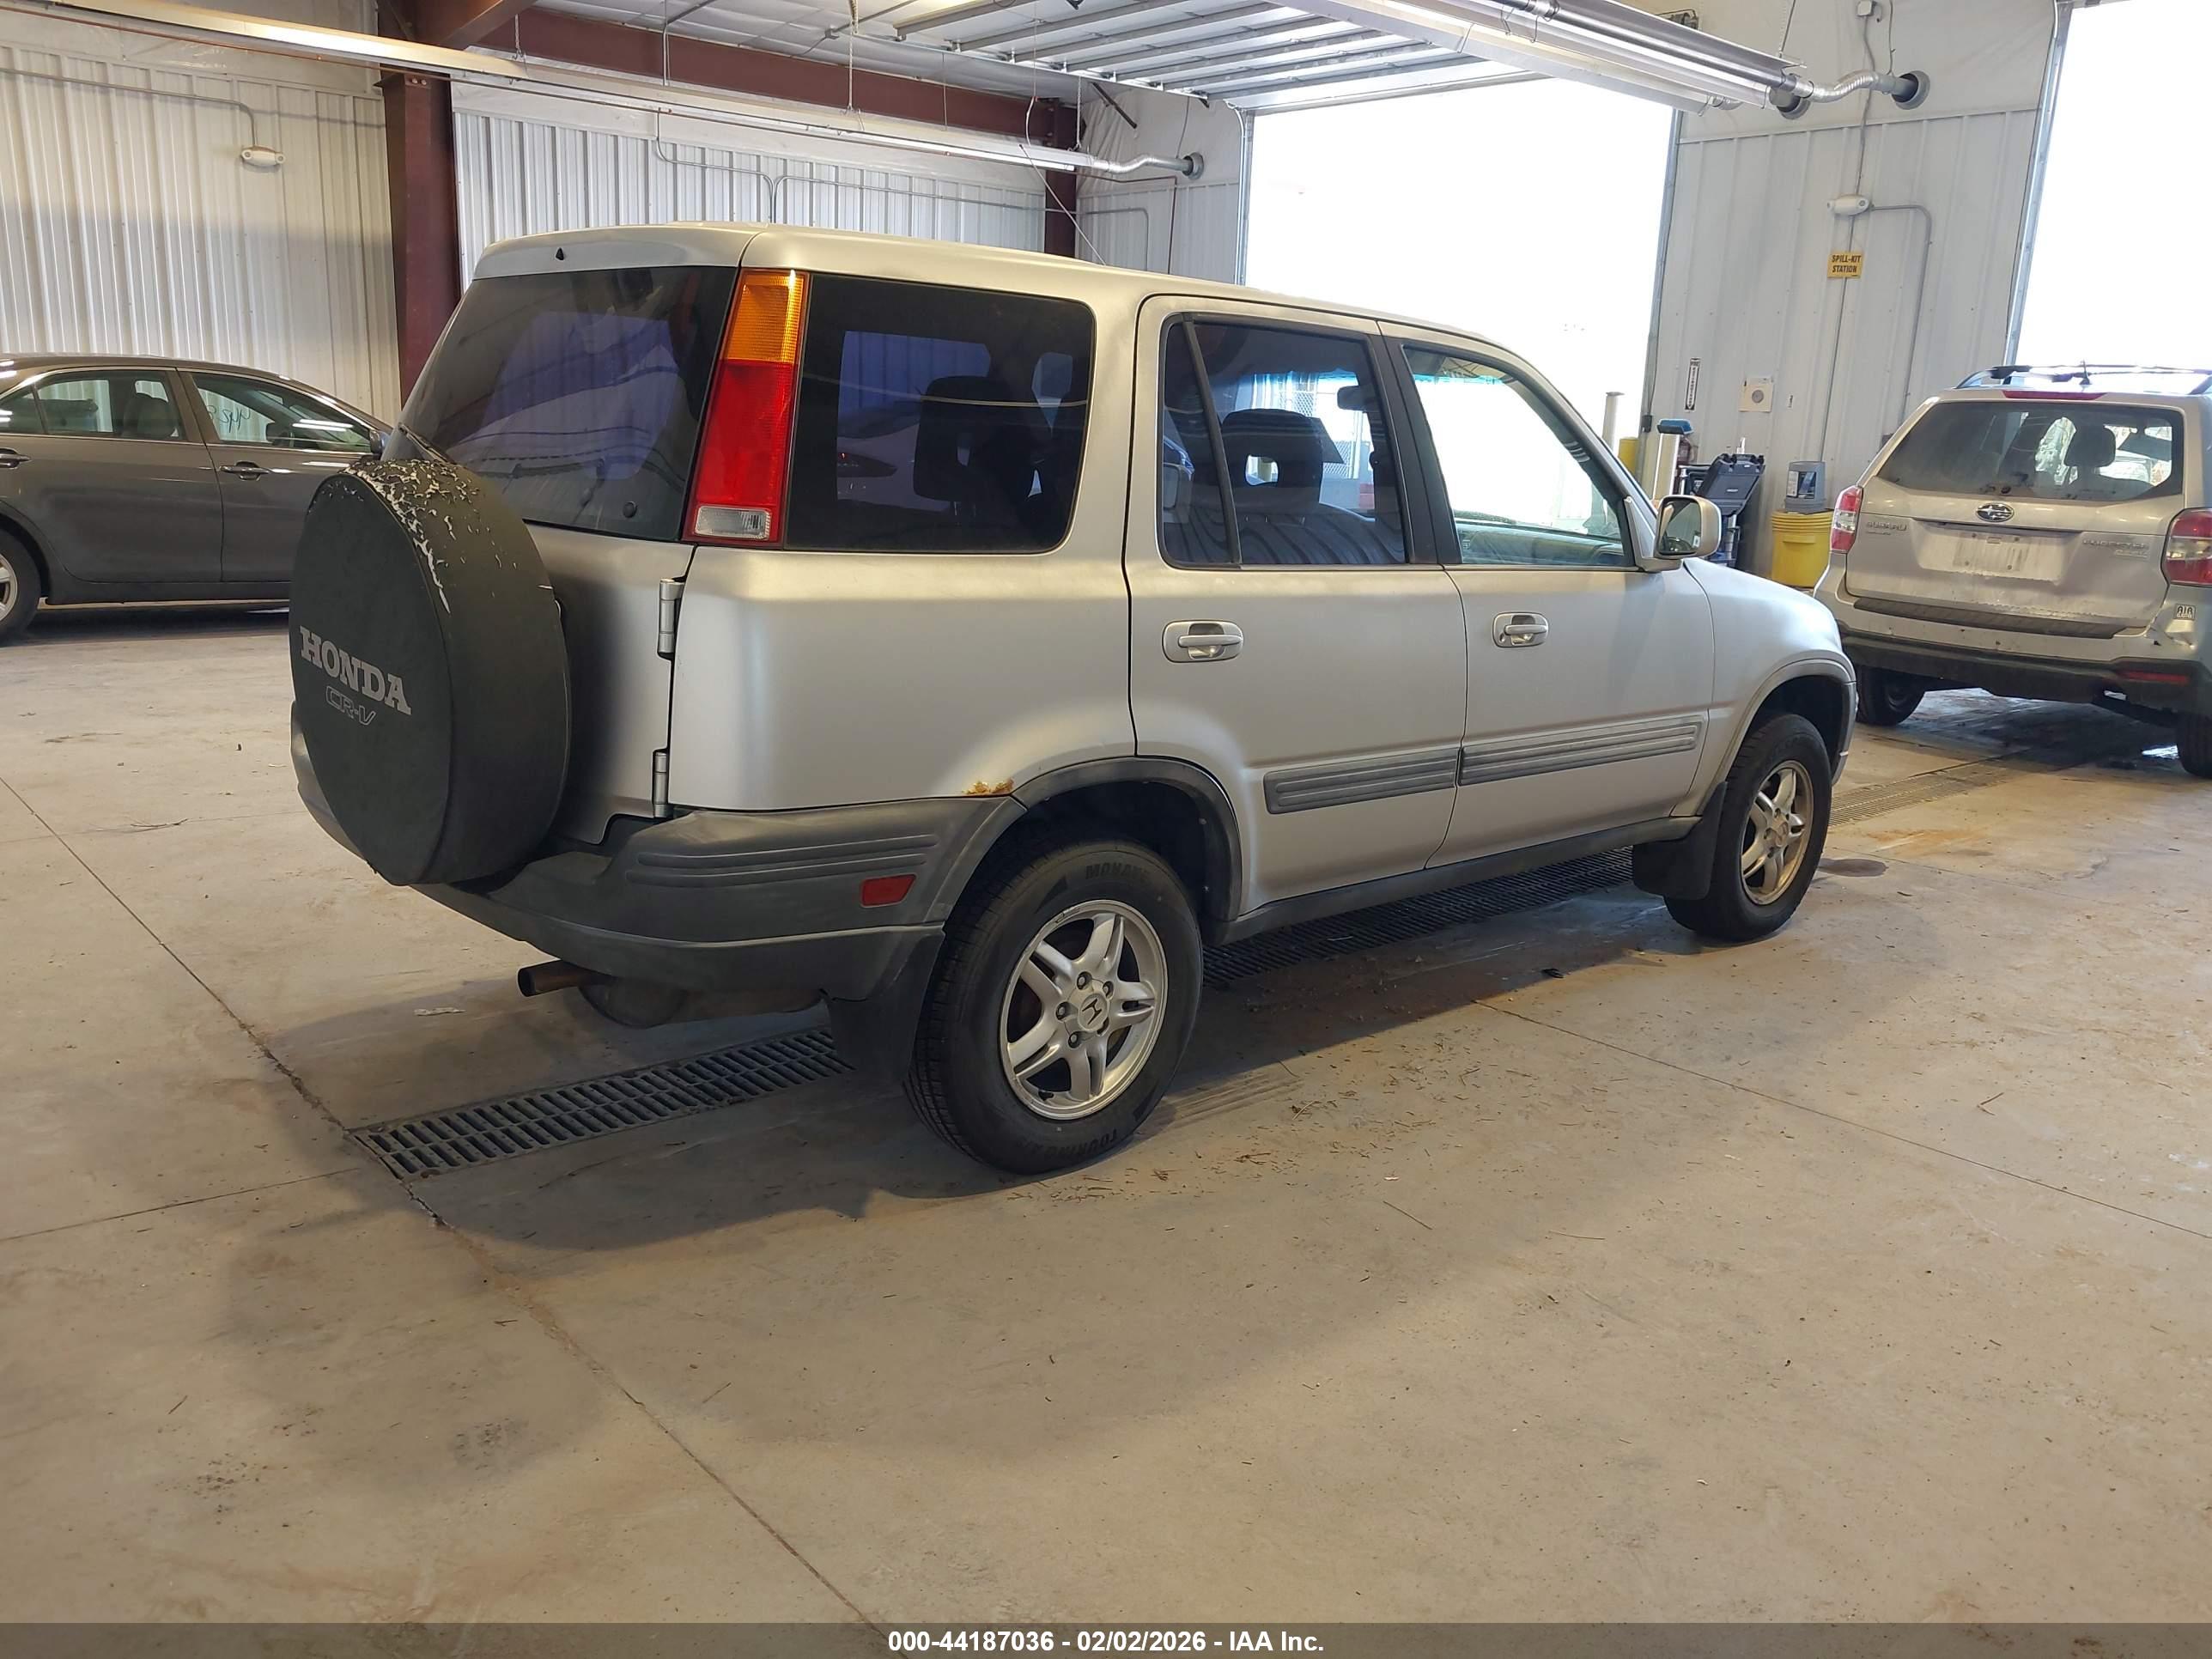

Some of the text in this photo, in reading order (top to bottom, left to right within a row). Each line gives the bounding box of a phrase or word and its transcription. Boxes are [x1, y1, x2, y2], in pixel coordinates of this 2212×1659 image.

[1832, 254, 1862, 263] SPILL-KIT
[1832, 264, 1857, 273] STATION
[300, 625, 411, 715] HONDA
[325, 685, 376, 726] CR-V
